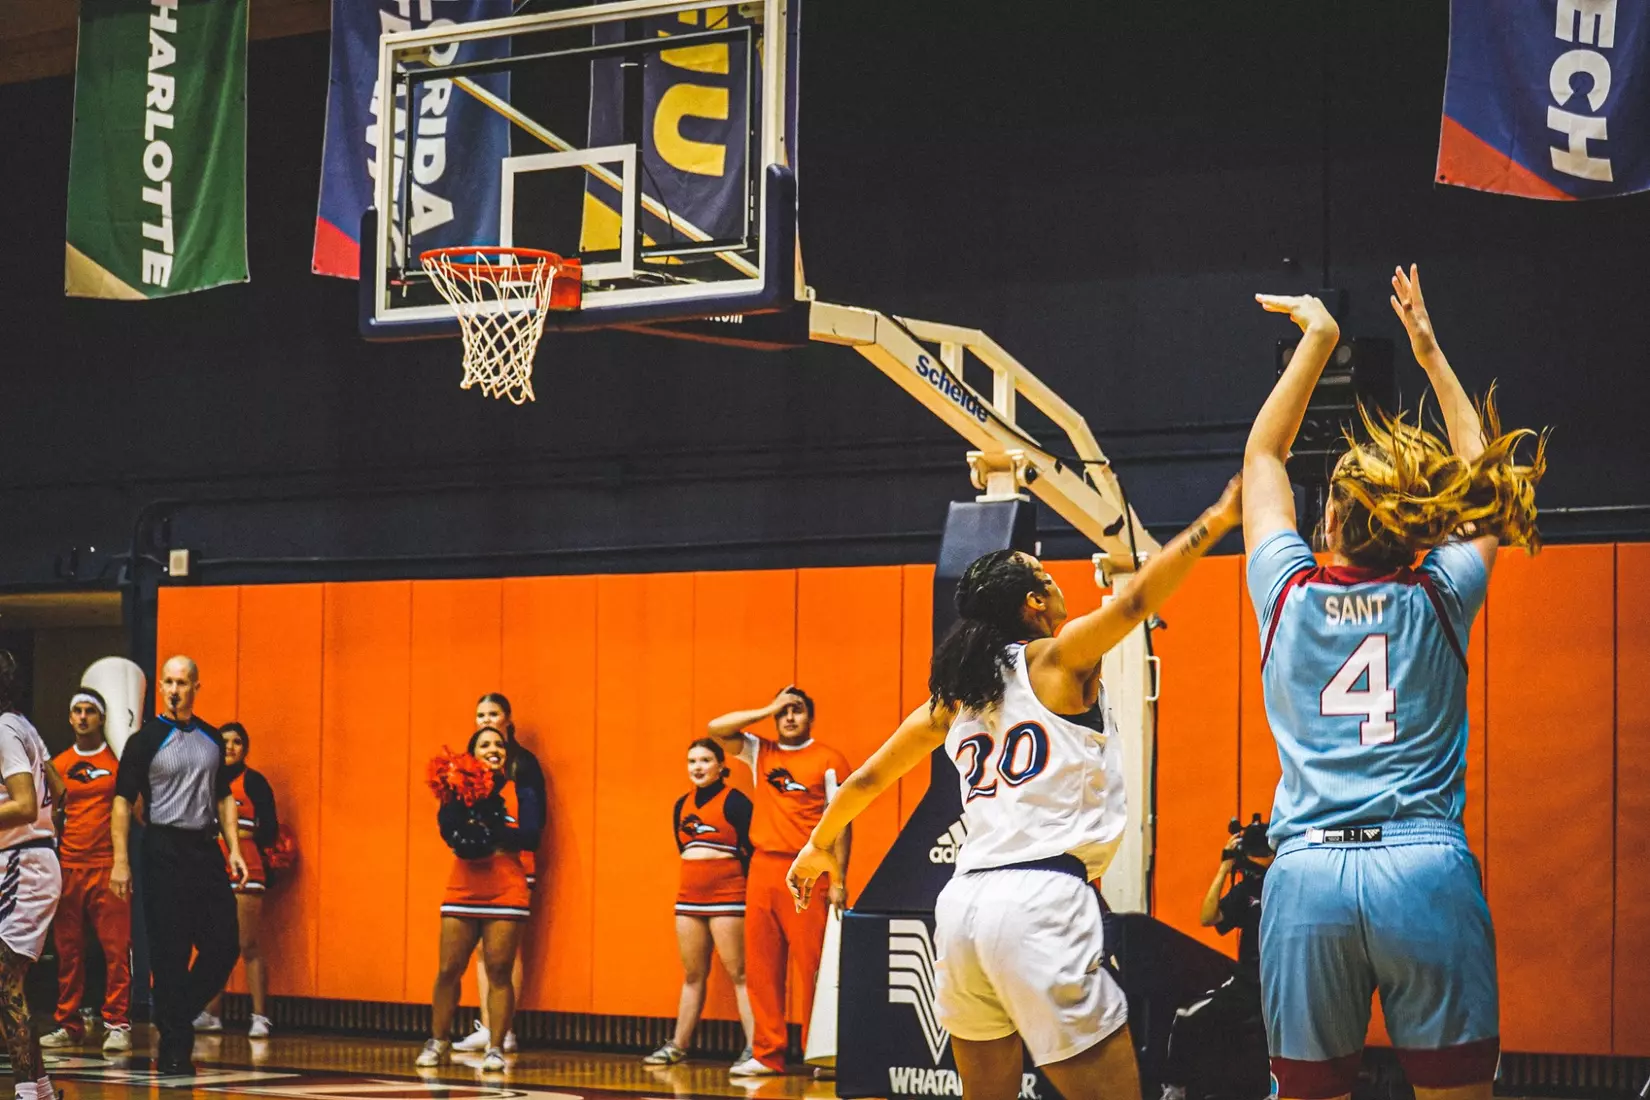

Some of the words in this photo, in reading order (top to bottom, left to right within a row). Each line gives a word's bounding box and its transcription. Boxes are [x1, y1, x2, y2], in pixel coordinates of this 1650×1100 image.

[1325, 593, 1387, 627] SANT
[1319, 633, 1397, 745] 4
[955, 720, 1050, 804] 20
